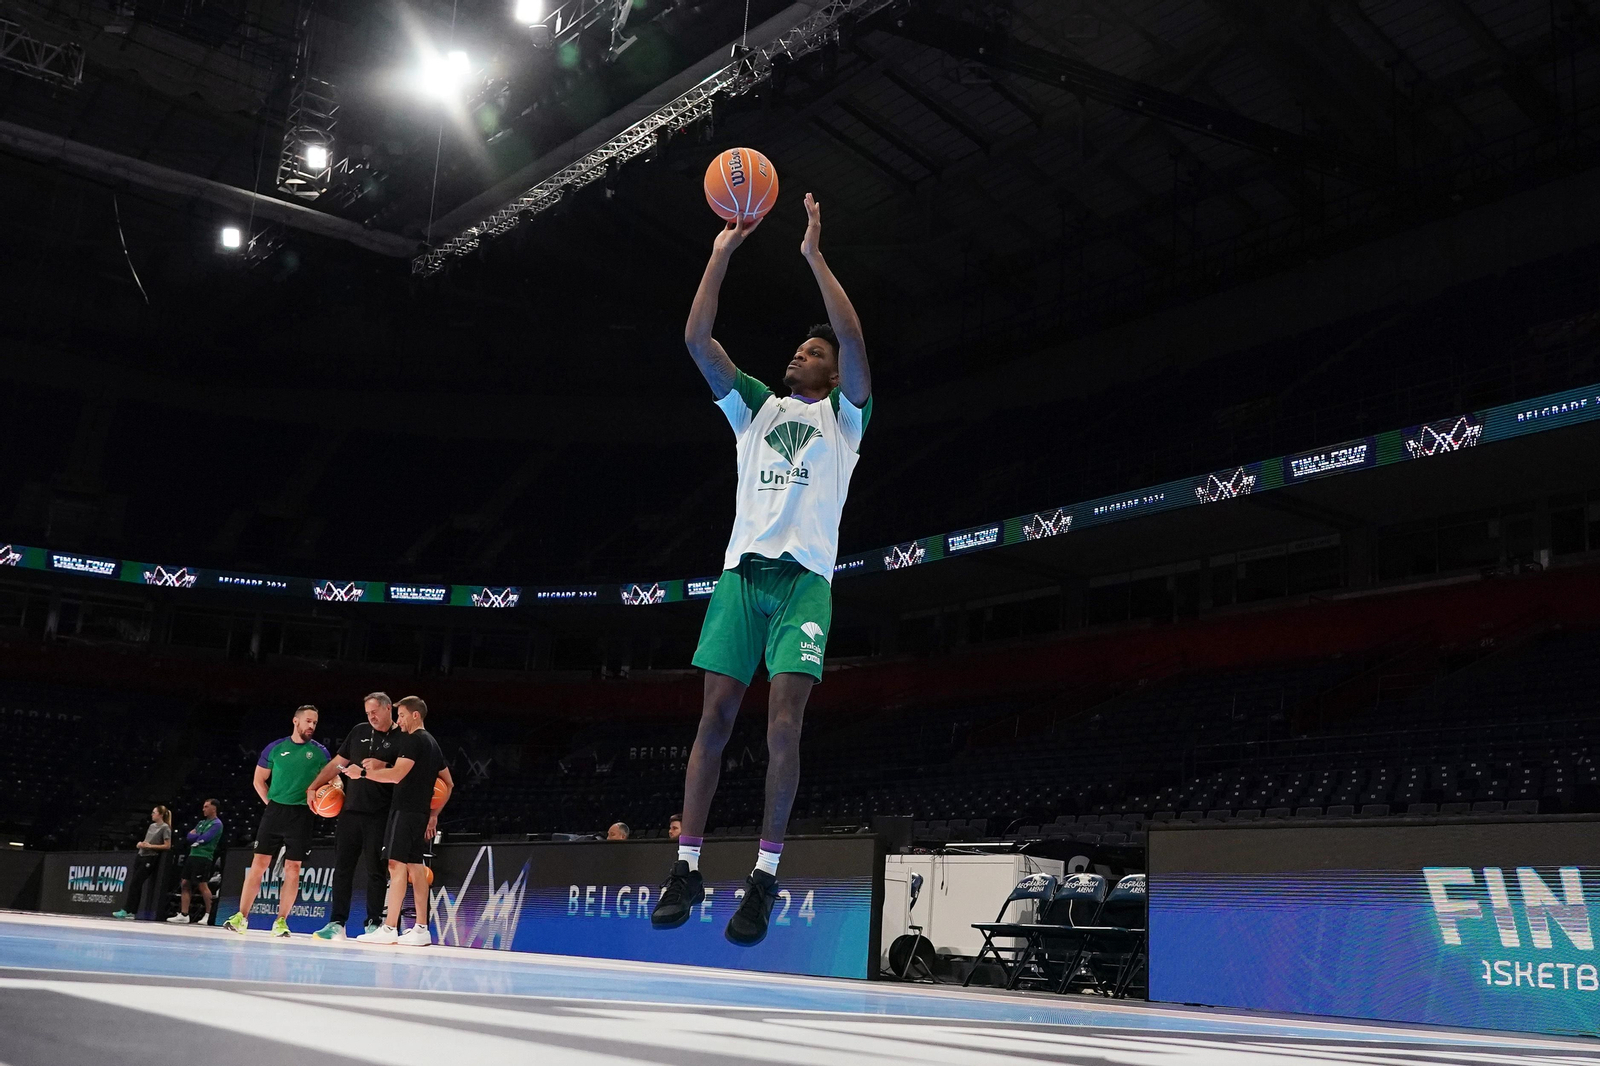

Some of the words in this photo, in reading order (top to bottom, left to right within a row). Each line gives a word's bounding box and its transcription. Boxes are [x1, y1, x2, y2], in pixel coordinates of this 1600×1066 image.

[1517, 398, 1588, 422] BELGRADE
[1291, 454, 1329, 471] FINAL
[1330, 445, 1367, 463] FOUR
[67, 865, 95, 891] FINAL
[96, 865, 128, 893] FOUR
[568, 884, 714, 923] BELGRE
